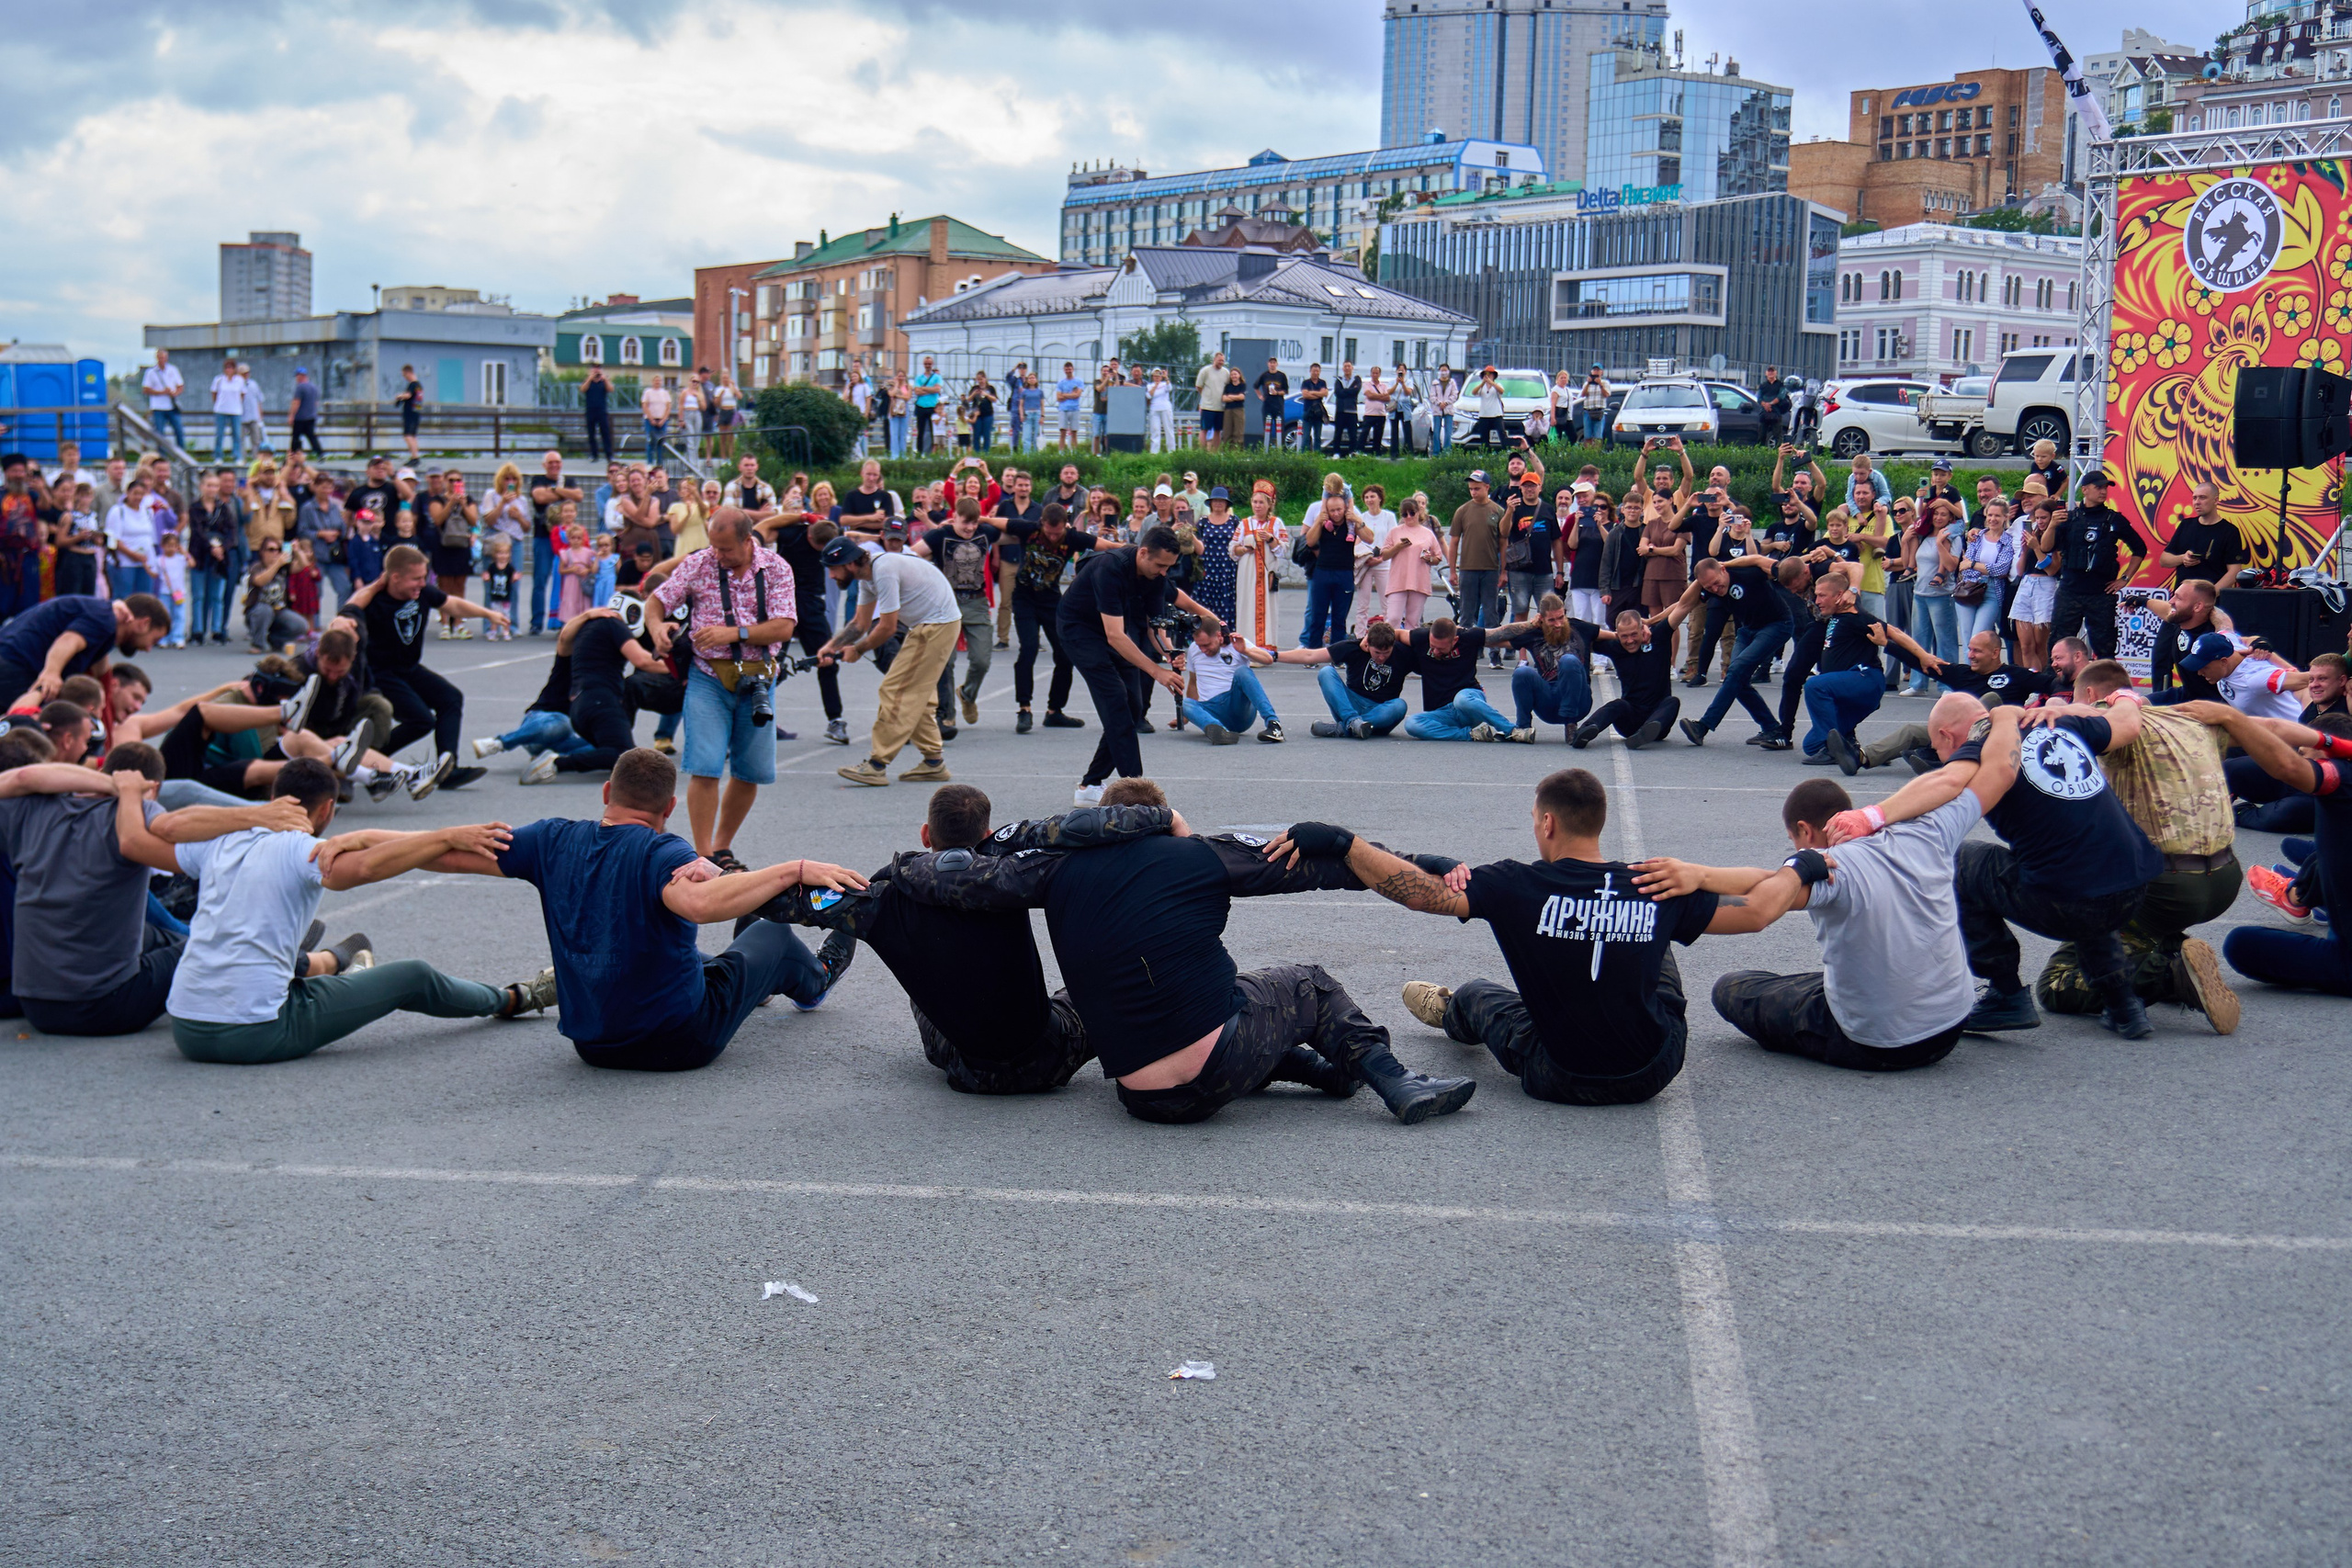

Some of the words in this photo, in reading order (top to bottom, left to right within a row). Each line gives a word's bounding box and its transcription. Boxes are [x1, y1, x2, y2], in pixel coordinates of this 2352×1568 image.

[2193, 183, 2278, 223] РУССКАЯ
[2194, 255, 2270, 288] ОБЩИНА
[1279, 339, 1303, 362] АДЪ
[1536, 895, 1657, 937] ДРУЖИНА
[1555, 929, 1585, 941] ЖИЗНЬ
[1589, 931, 1600, 942] ЗА
[1605, 932, 1631, 942] ДРУГИ
